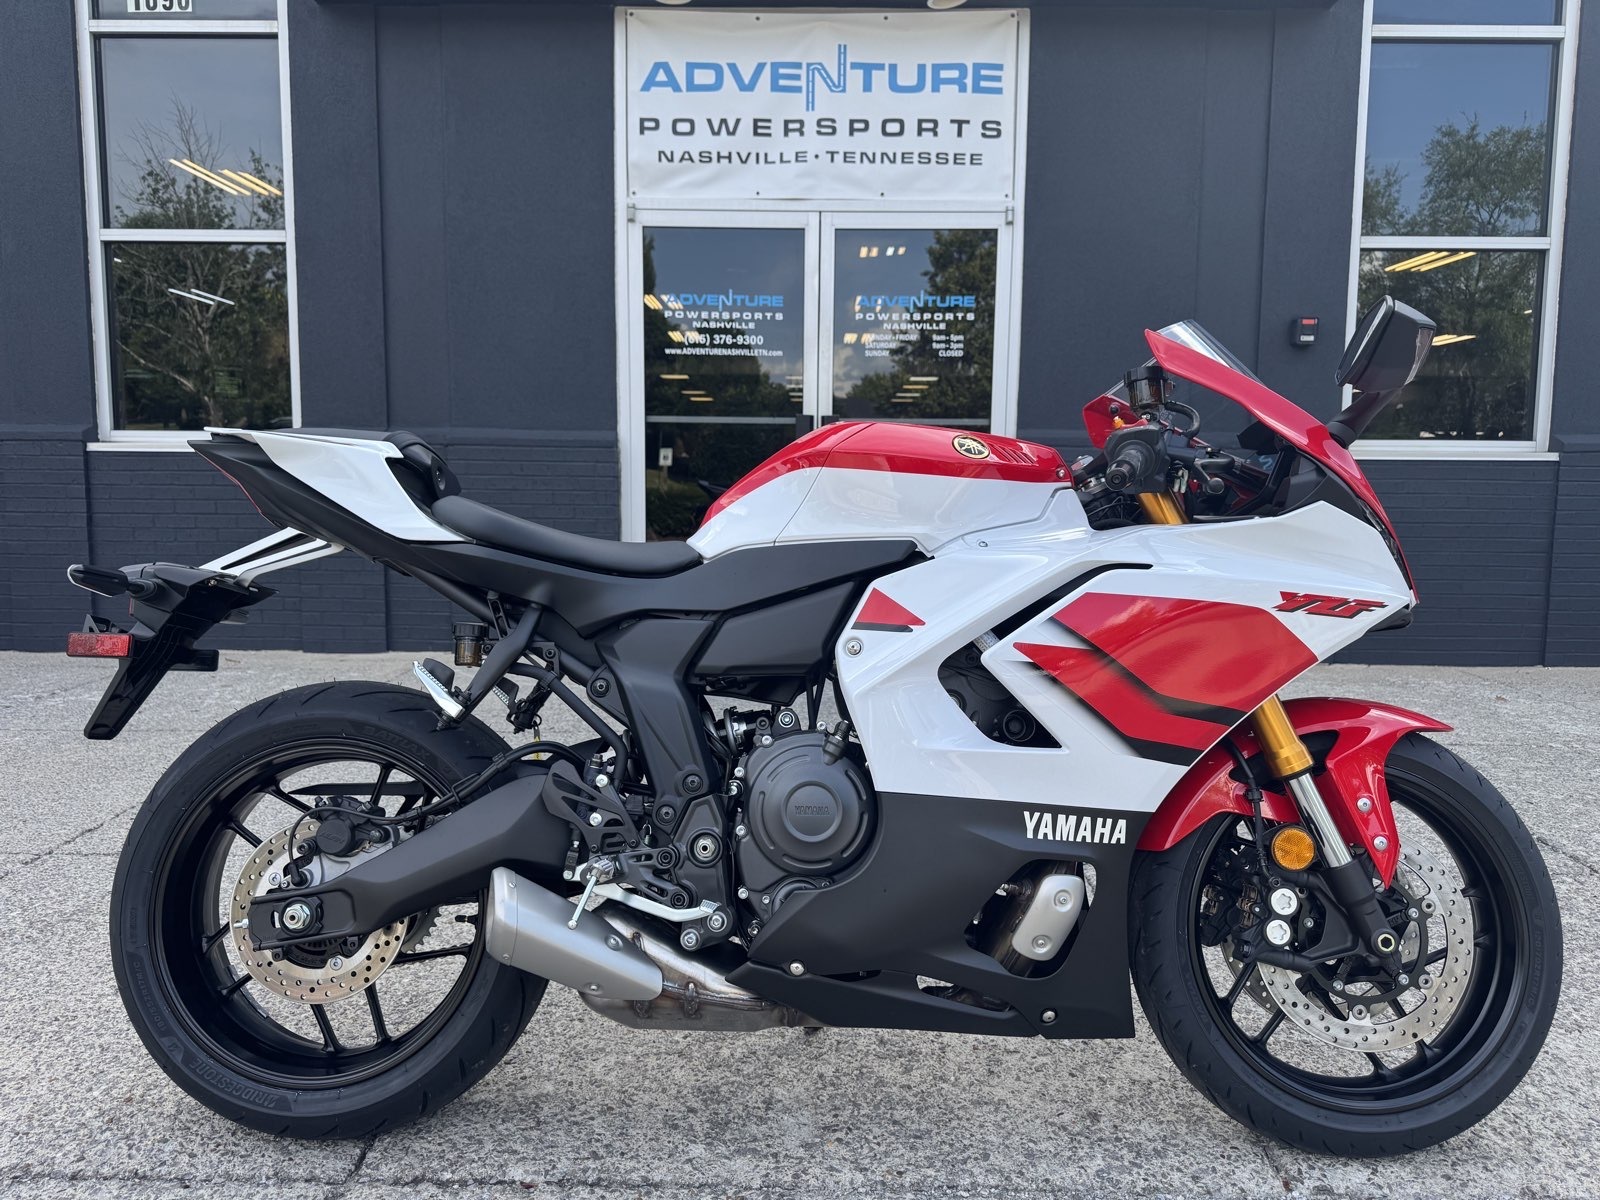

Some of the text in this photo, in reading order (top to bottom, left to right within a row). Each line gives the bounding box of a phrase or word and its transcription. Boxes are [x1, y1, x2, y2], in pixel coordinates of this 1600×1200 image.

[639, 43, 1004, 112] ADVENTURE
[638, 117, 1003, 139] POWERSPORTS
[657, 149, 984, 166] NASHVILLE TENNESSEE
[666, 289, 784, 312] ADVENTURE
[857, 289, 977, 313] ADVENTURE
[663, 310, 784, 321] POWERSPORTS
[855, 312, 976, 321] POWERSPORTS
[692, 321, 756, 330] NASHVILLE
[883, 322, 947, 330] NASHVILLE
[713, 334, 764, 345] 376-9300
[865, 341, 897, 349] SATURDAY
[865, 349, 890, 357] SUNDAY
[938, 349, 964, 357] CLOSED
[1272, 590, 1389, 619] YZF
[794, 805, 830, 816] YAMAHA
[1023, 810, 1127, 844] YAMAHA
[187, 1056, 281, 1109] BRIDGESTONE
